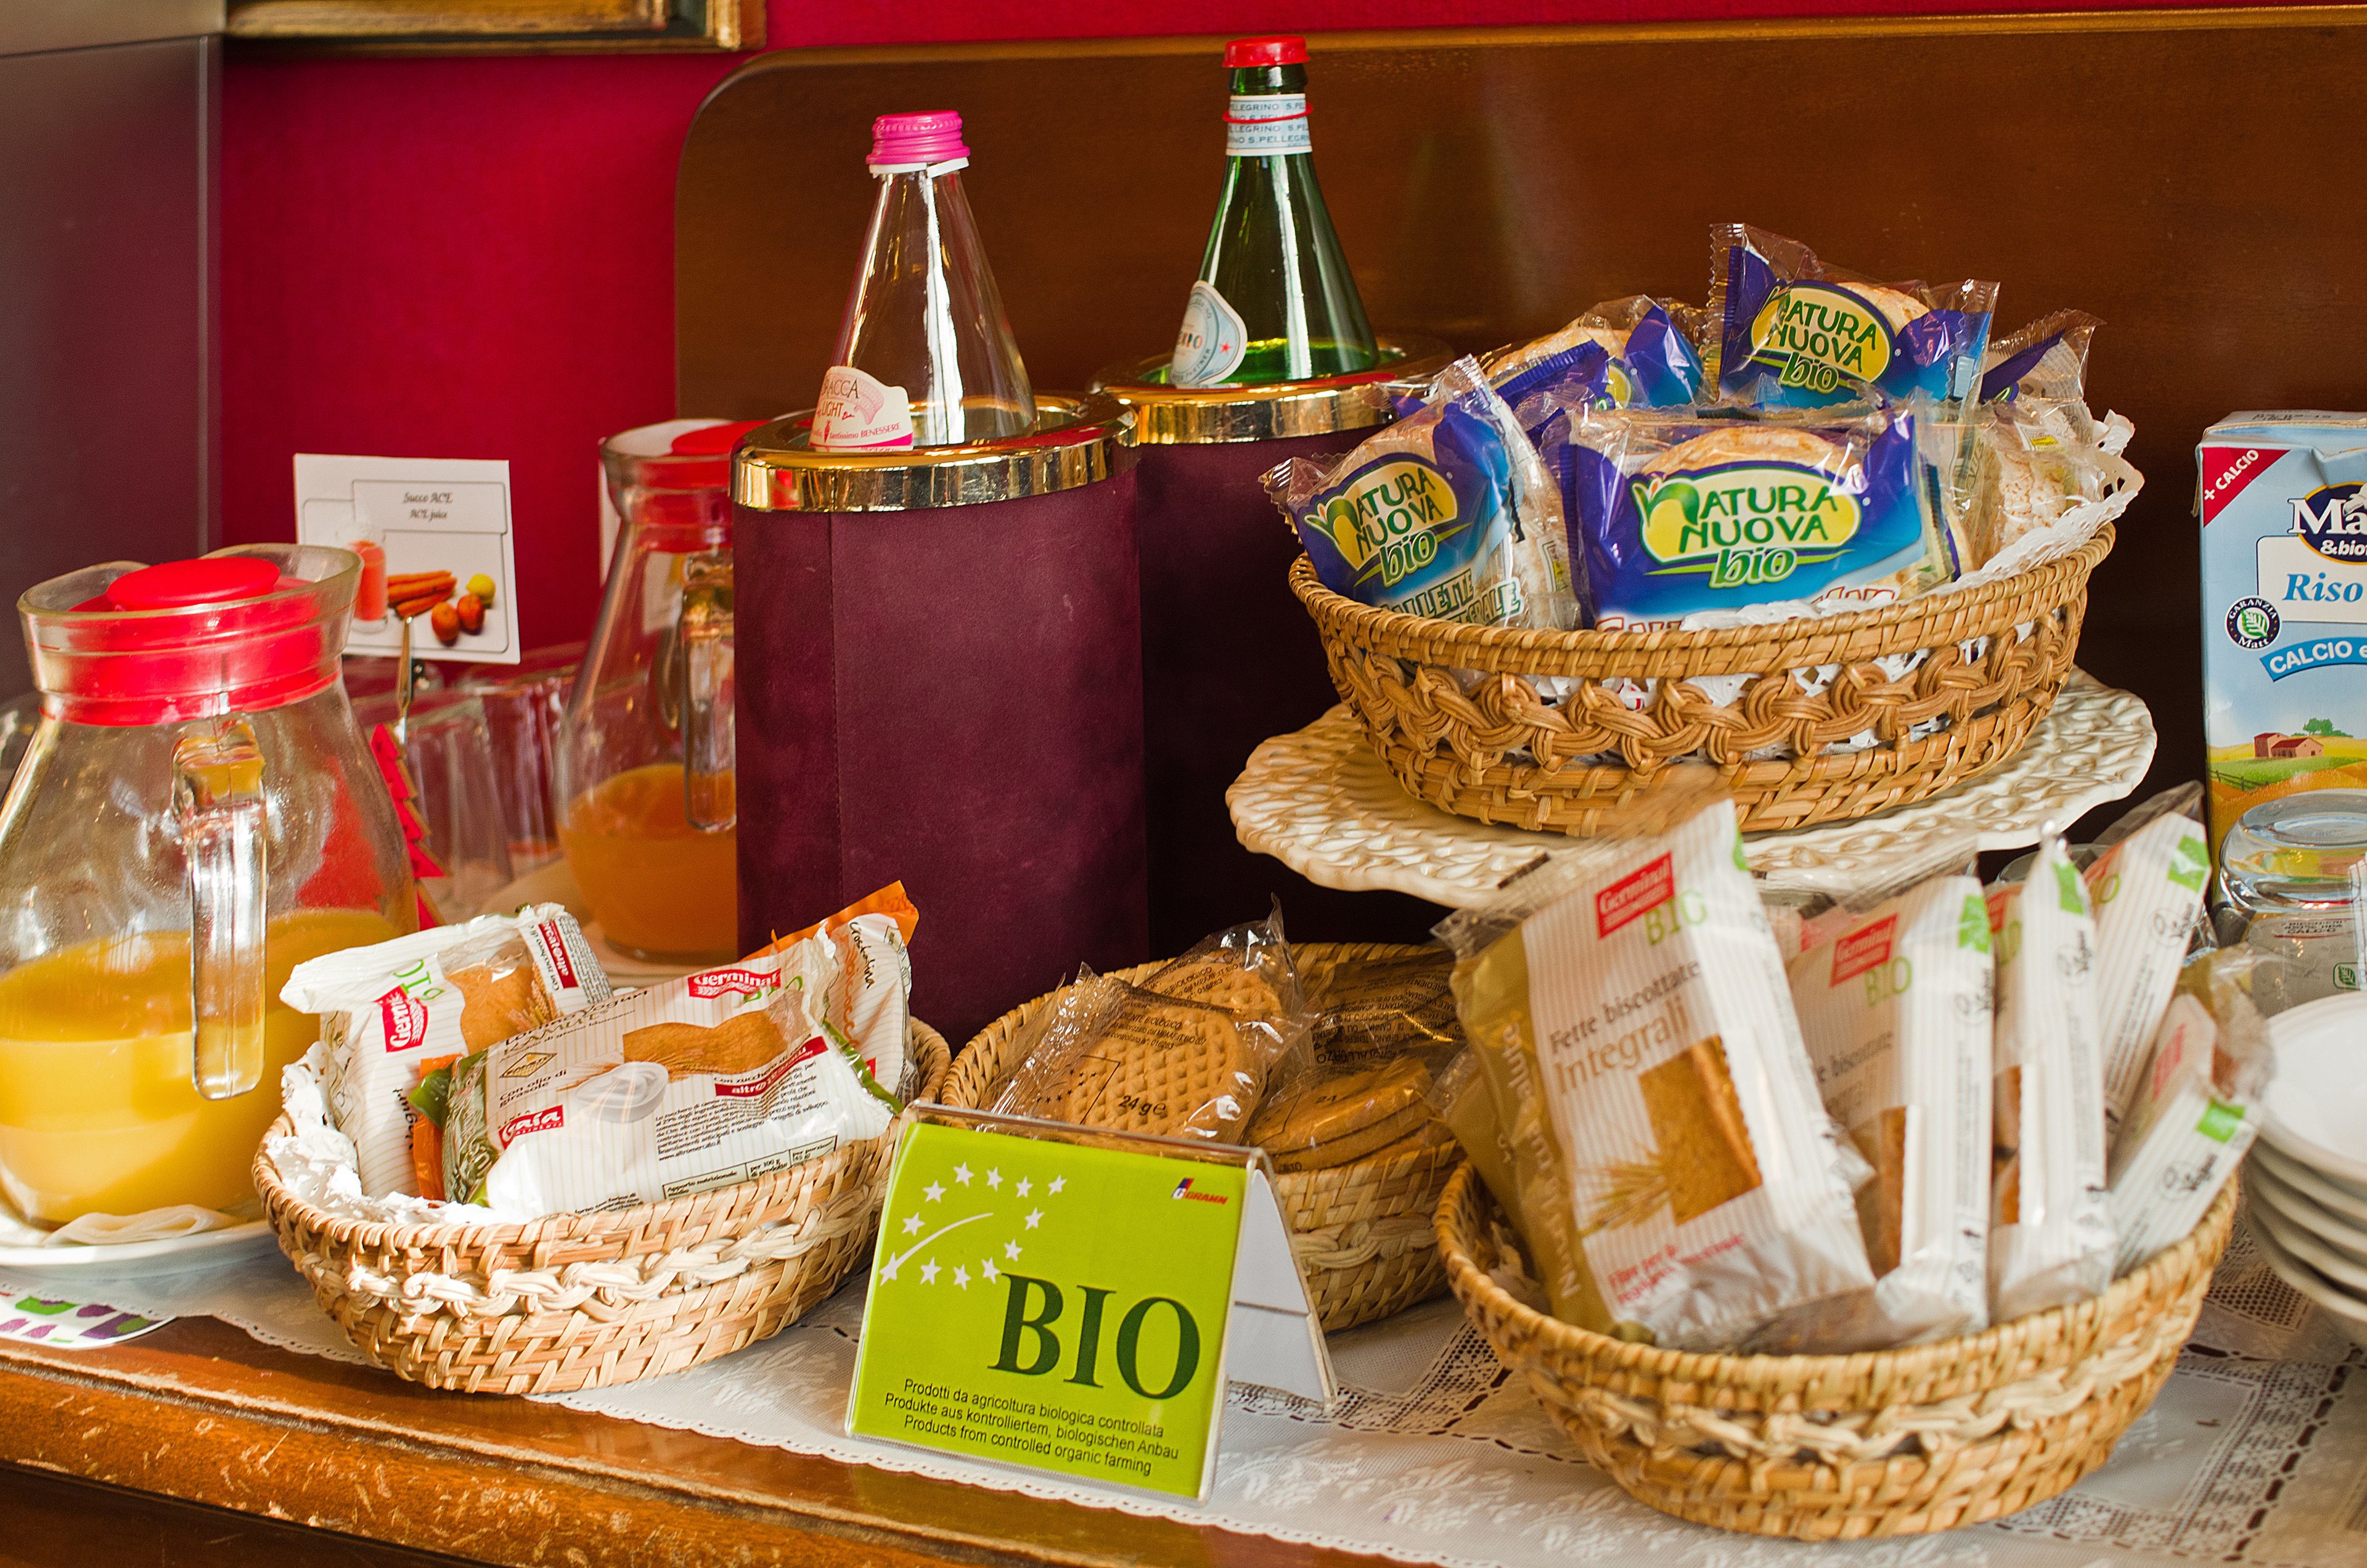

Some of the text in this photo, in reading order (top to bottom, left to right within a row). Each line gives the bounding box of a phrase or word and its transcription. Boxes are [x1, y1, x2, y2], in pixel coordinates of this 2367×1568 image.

[1765, 323, 1863, 373] NUOVA
[1780, 351, 1840, 394] bio
[861, 422, 901, 438] BENESSERE
[2215, 449, 2259, 490] CALCIO
[403, 492, 428, 503] Succo
[429, 510, 448, 523] juice
[1327, 467, 1436, 533] NATURA
[1647, 478, 1841, 526] NATURA
[1356, 494, 1444, 561] NUOVA
[1679, 515, 1829, 555] NUOVA
[1380, 529, 1438, 588] bio
[1710, 546, 1797, 589] bio
[2283, 572, 2363, 602] Riso
[2229, 598, 2278, 619] GARANZIA
[2238, 635, 2270, 649] Matt
[2270, 640, 2353, 674] CALCIO
[849, 921, 877, 990] Crostatina
[693, 971, 781, 987] Germinal
[1864, 955, 1913, 1009] BIO
[1145, 1017, 1183, 1030] BIOLOGICO
[1548, 959, 1701, 1054] Fette biscottate
[1110, 1032, 1141, 1044] controllato
[1552, 993, 1690, 1095] Integrali
[499, 1069, 567, 1101] Con olio di
[735, 1063, 778, 1084] zucchero
[499, 1081, 549, 1108] girasole
[1118, 1095, 1139, 1110] 24
[502, 1111, 562, 1143] Gaia
[750, 1164, 761, 1174] per
[762, 1159, 775, 1167] 100
[987, 1272, 1201, 1401] BIO
[885, 1392, 1179, 1460] Produkte aus kontrolliertem, biologischen Anbau
[904, 1378, 1164, 1438] Prodotti da agricoltura biologica controllata
[904, 1414, 1102, 1464] Products from controlled organic
